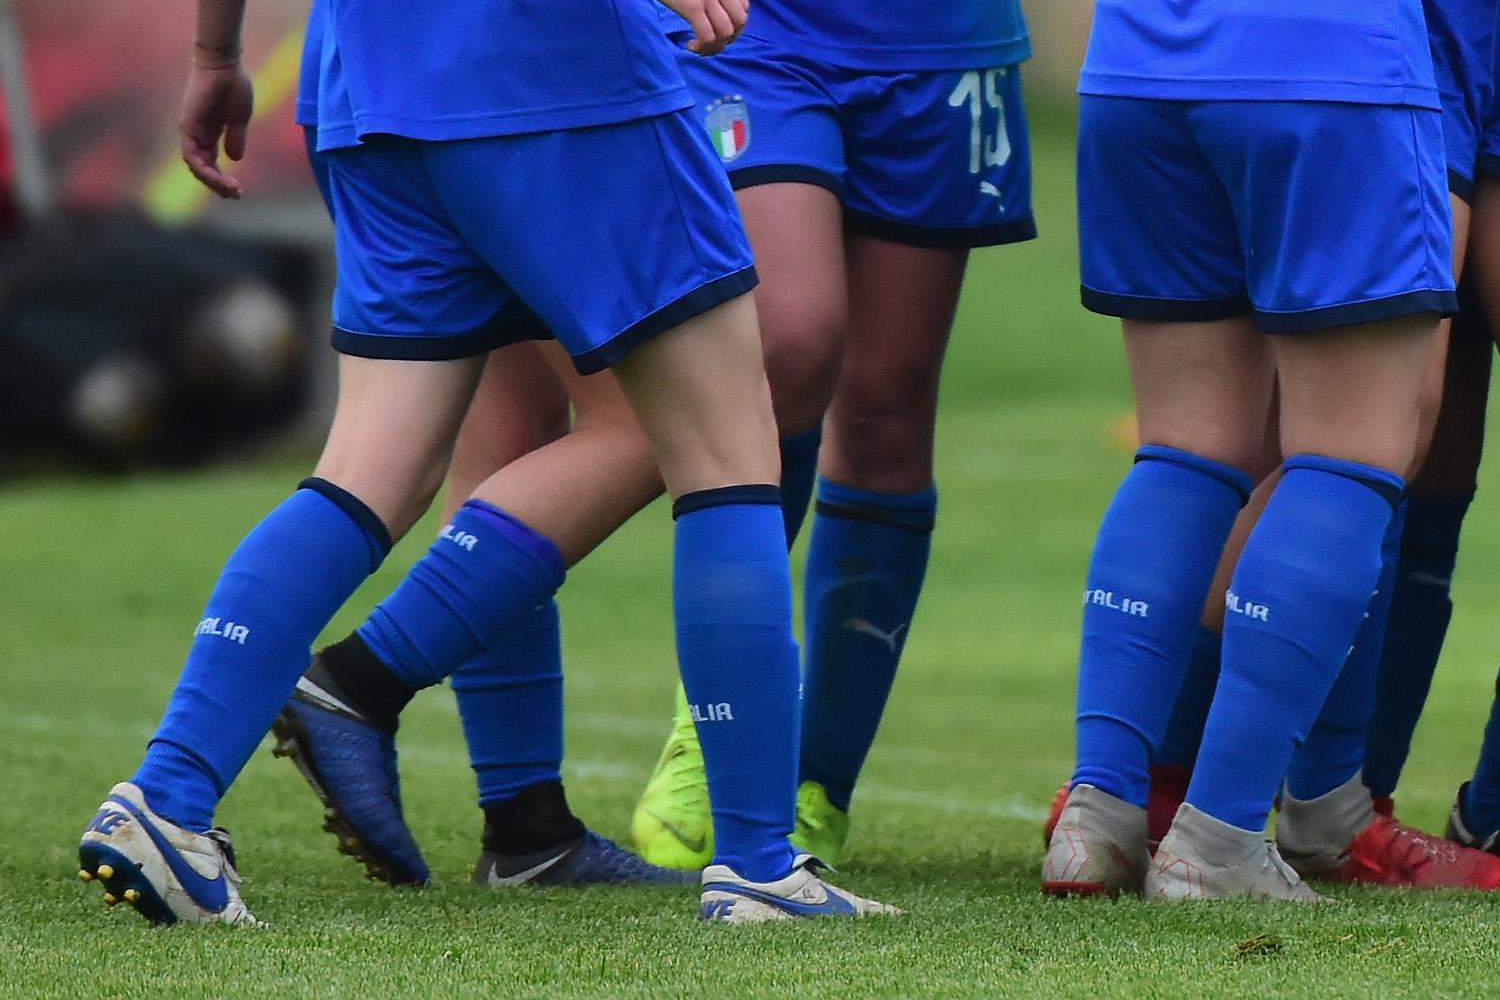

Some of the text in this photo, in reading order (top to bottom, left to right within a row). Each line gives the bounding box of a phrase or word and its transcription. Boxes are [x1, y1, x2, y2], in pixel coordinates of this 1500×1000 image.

[948, 68, 1011, 174] 15
[1084, 589, 1148, 617] TALIA
[1225, 589, 1269, 621] ALIA
